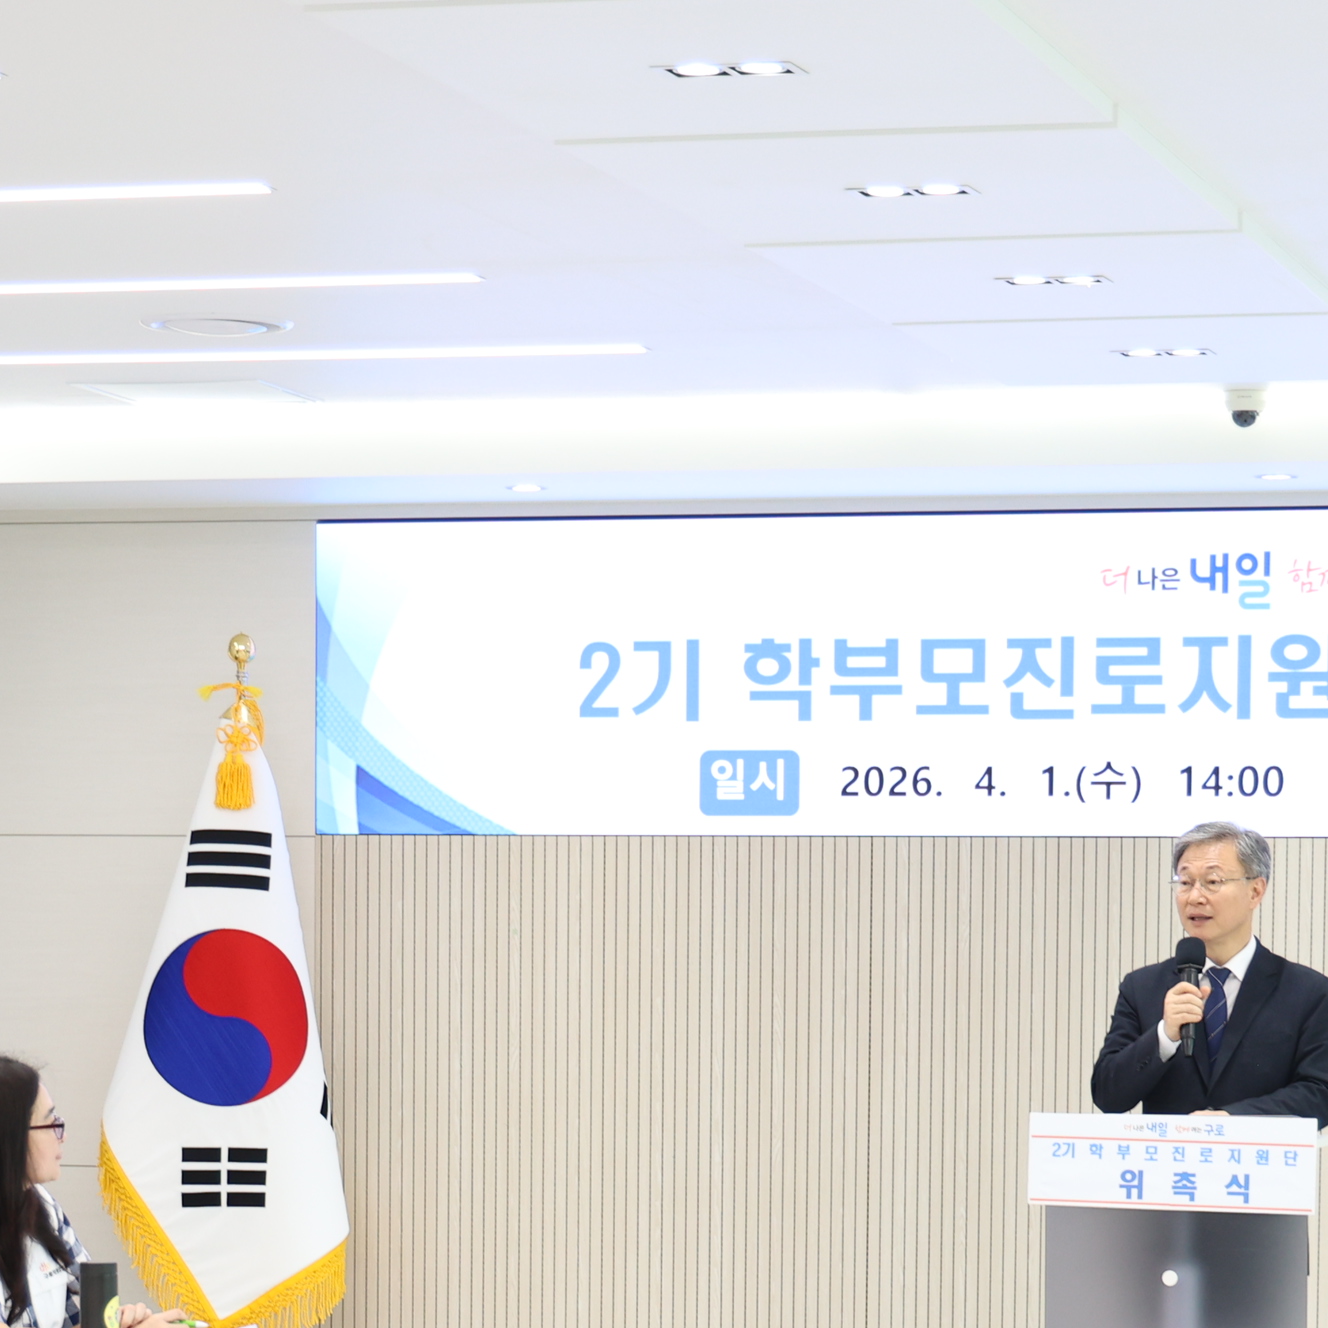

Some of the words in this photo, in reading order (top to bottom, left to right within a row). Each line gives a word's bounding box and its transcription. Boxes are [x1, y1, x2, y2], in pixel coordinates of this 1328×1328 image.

[1101, 566, 1130, 595] 더
[1138, 568, 1181, 592] 나은
[1190, 551, 1271, 611] 내일
[580, 640, 700, 722] 2기
[712, 757, 785, 802] 일시
[841, 766, 943, 798] 2026.
[975, 766, 1007, 798] 4.
[1180, 766, 1285, 798] 14:00
[1052, 1142, 1076, 1160] 2기
[1146, 1122, 1168, 1137] 내일
[1204, 1124, 1225, 1136] 구로
